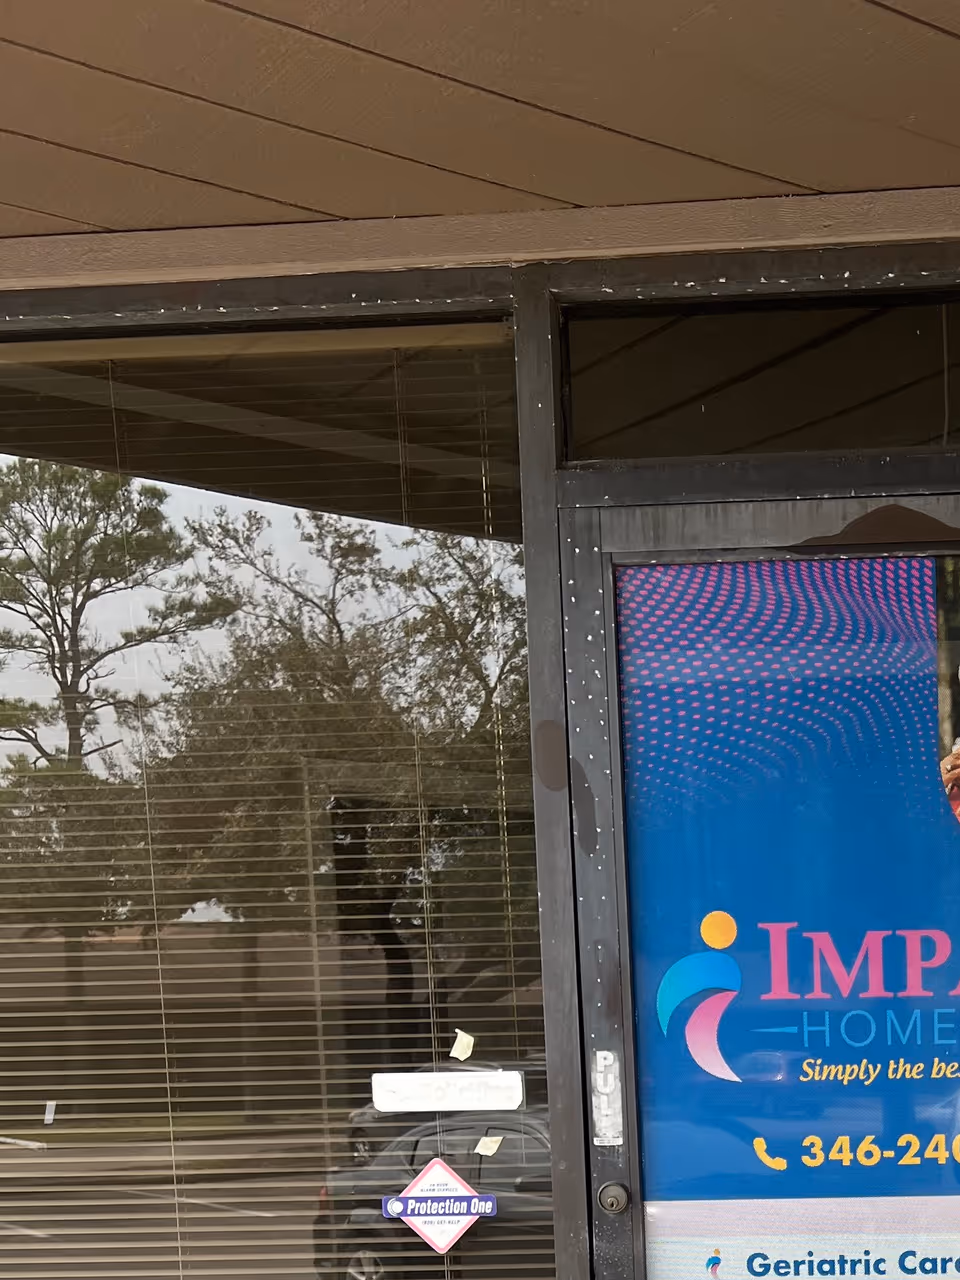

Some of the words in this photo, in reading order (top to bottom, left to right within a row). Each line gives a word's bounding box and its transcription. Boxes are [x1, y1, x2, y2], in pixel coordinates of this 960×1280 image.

[803, 1008, 958, 1047] HOME
[800, 1059, 881, 1085] Simply
[888, 1059, 924, 1079] the
[596, 1050, 615, 1136] PUL
[406, 1198, 468, 1215] Protection
[470, 1198, 493, 1214] One
[746, 1249, 887, 1278] Geriatric
